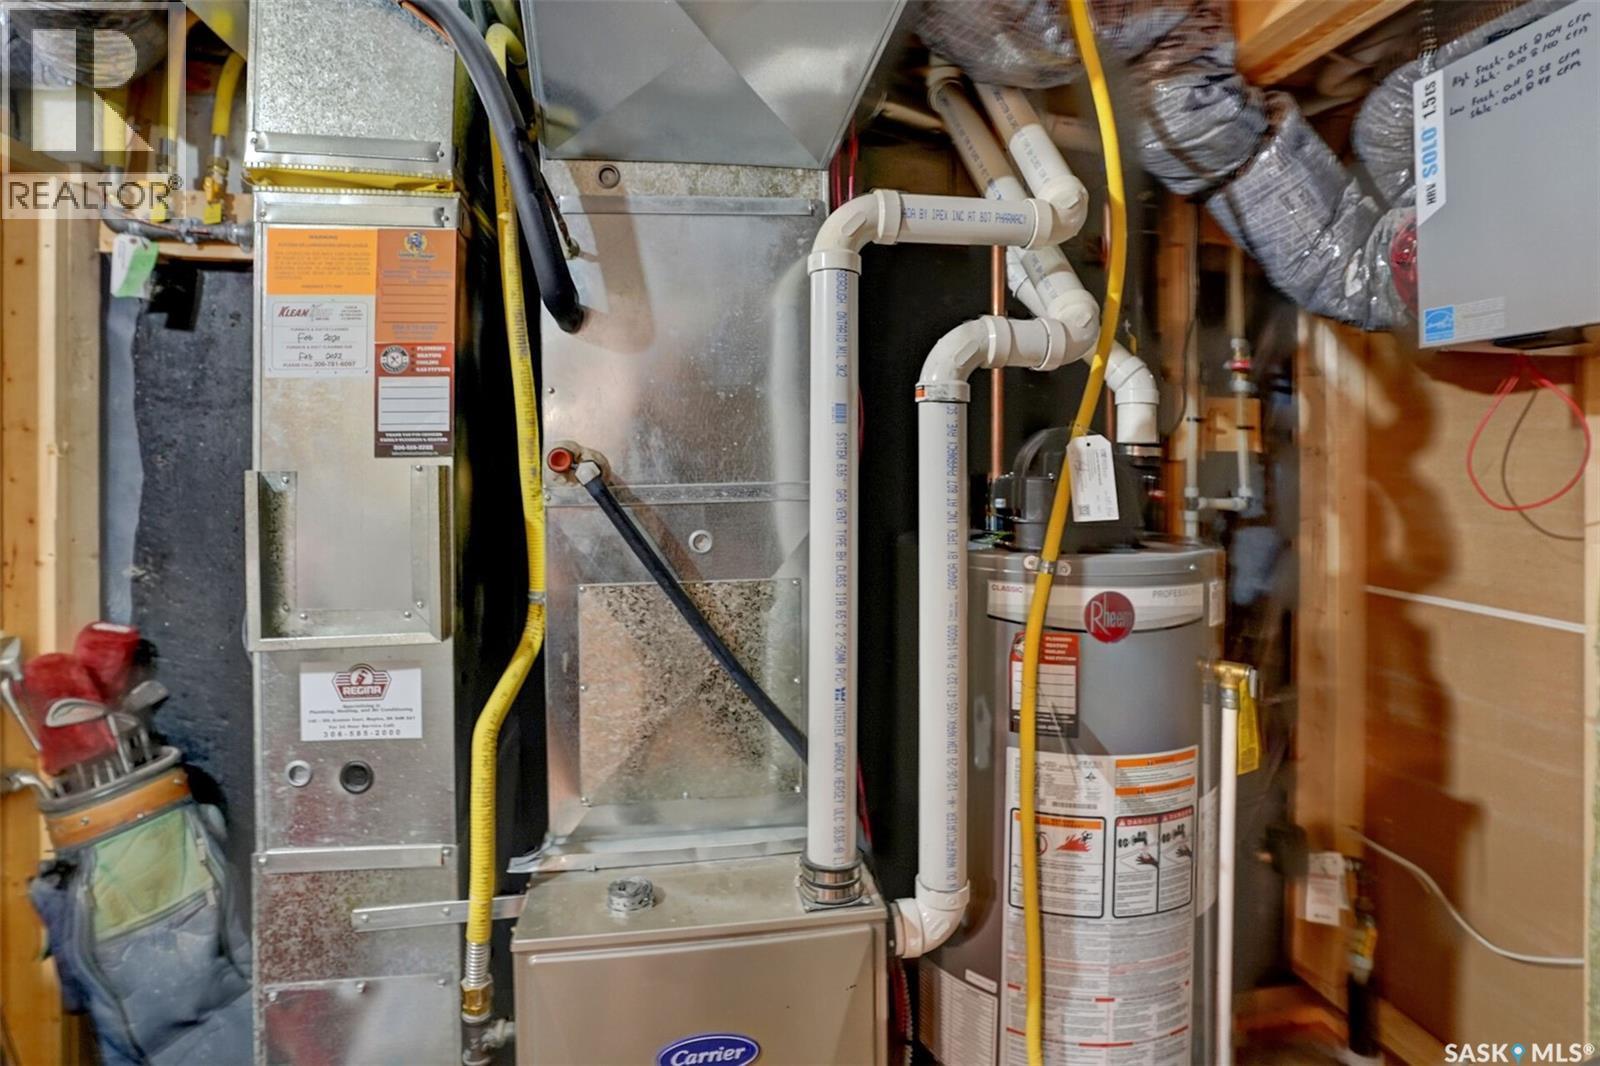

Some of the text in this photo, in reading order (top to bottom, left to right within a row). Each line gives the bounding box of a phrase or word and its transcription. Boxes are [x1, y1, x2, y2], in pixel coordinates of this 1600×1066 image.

[1420, 126, 1439, 178] SOLO
[1426, 183, 1437, 206] HRV
[920, 208, 928, 220] BY
[932, 208, 948, 221] IPEX
[952, 210, 964, 222] INC
[967, 210, 977, 222] AT
[836, 432, 848, 460] SYSTEM
[946, 442, 958, 476] PHARMACY
[836, 488, 848, 503] GAS
[947, 499, 958, 508] AT
[836, 506, 848, 524] VENT
[947, 511, 958, 524] INC
[836, 530, 848, 548] TYPE
[947, 530, 958, 545] IPEX
[947, 552, 958, 560] BY
[835, 564, 848, 588] CLASS
[947, 563, 958, 590] CANADA
[992, 584, 1023, 593] CLASSIC
[1090, 592, 1133, 636] Rheem
[834, 702, 846, 738] INTERTEK
[670, 1046, 746, 1066] Carrier
